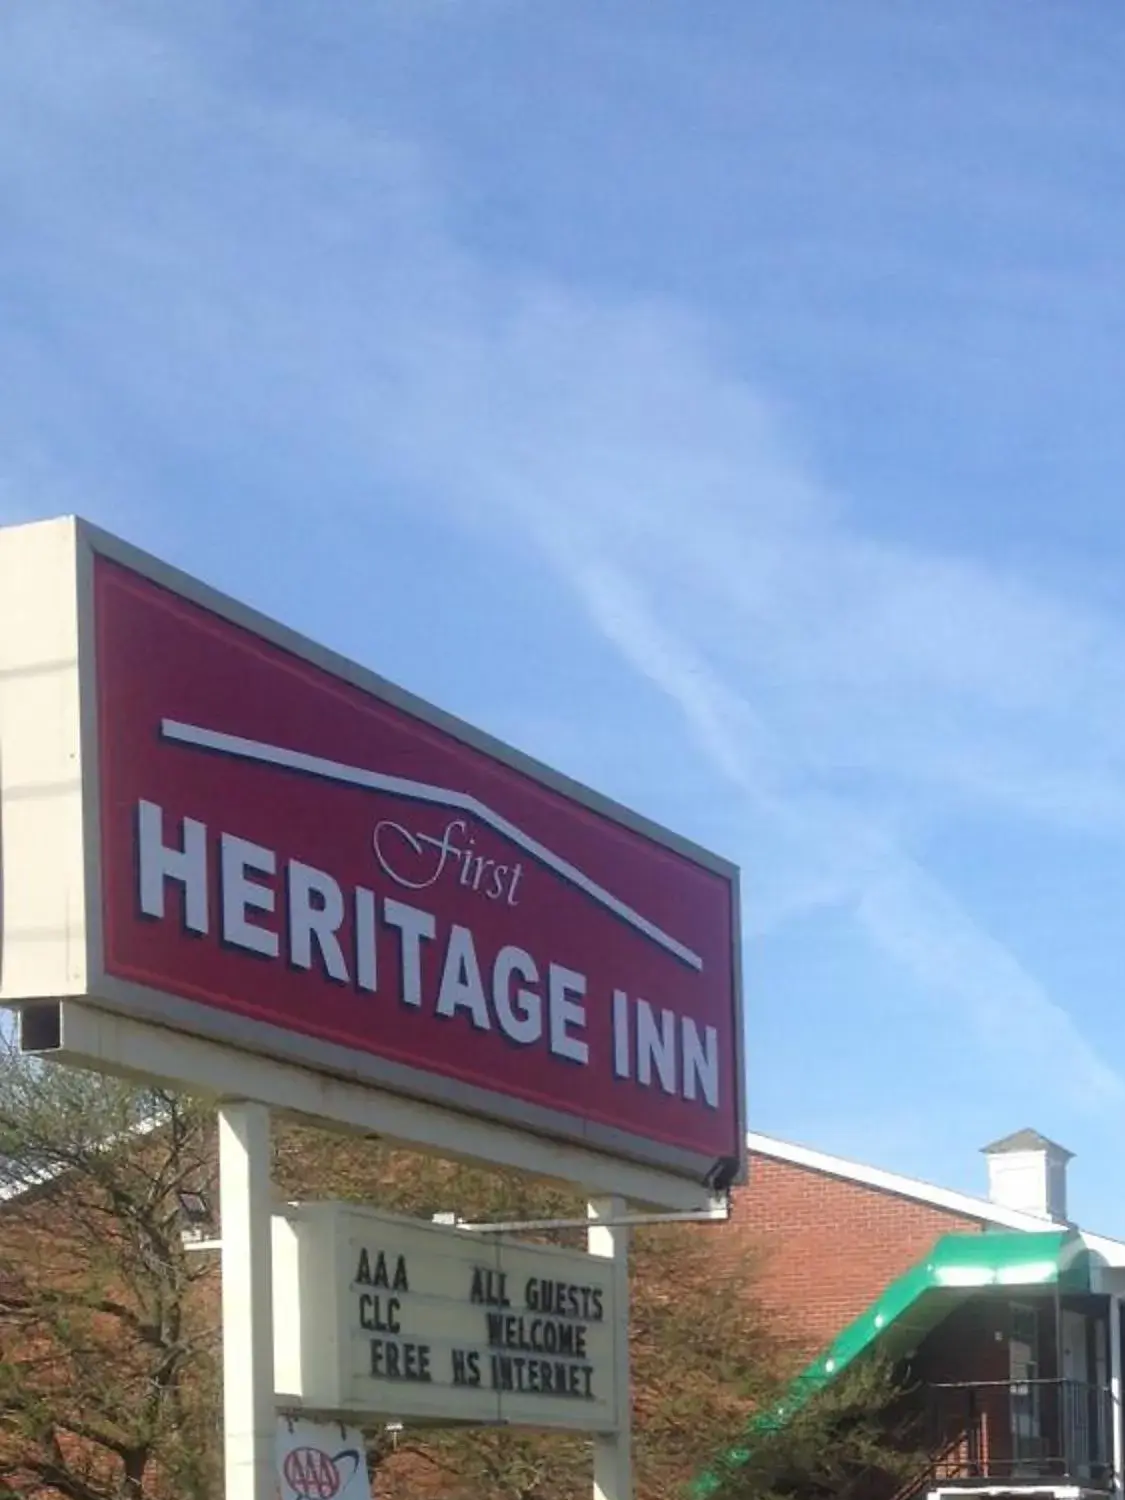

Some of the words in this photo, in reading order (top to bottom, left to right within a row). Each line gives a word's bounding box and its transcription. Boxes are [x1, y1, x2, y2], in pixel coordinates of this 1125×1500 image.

[374, 821, 522, 905] First
[138, 798, 589, 1065] HERITAGE
[612, 988, 719, 1109] INN
[354, 1247, 408, 1292] AAA
[470, 1265, 510, 1308] ALL
[525, 1276, 603, 1321] GUESTS
[360, 1293, 401, 1333] CLC
[487, 1312, 587, 1359] WELCOME
[370, 1338, 432, 1383] FREE
[491, 1354, 594, 1399] INTERNET
